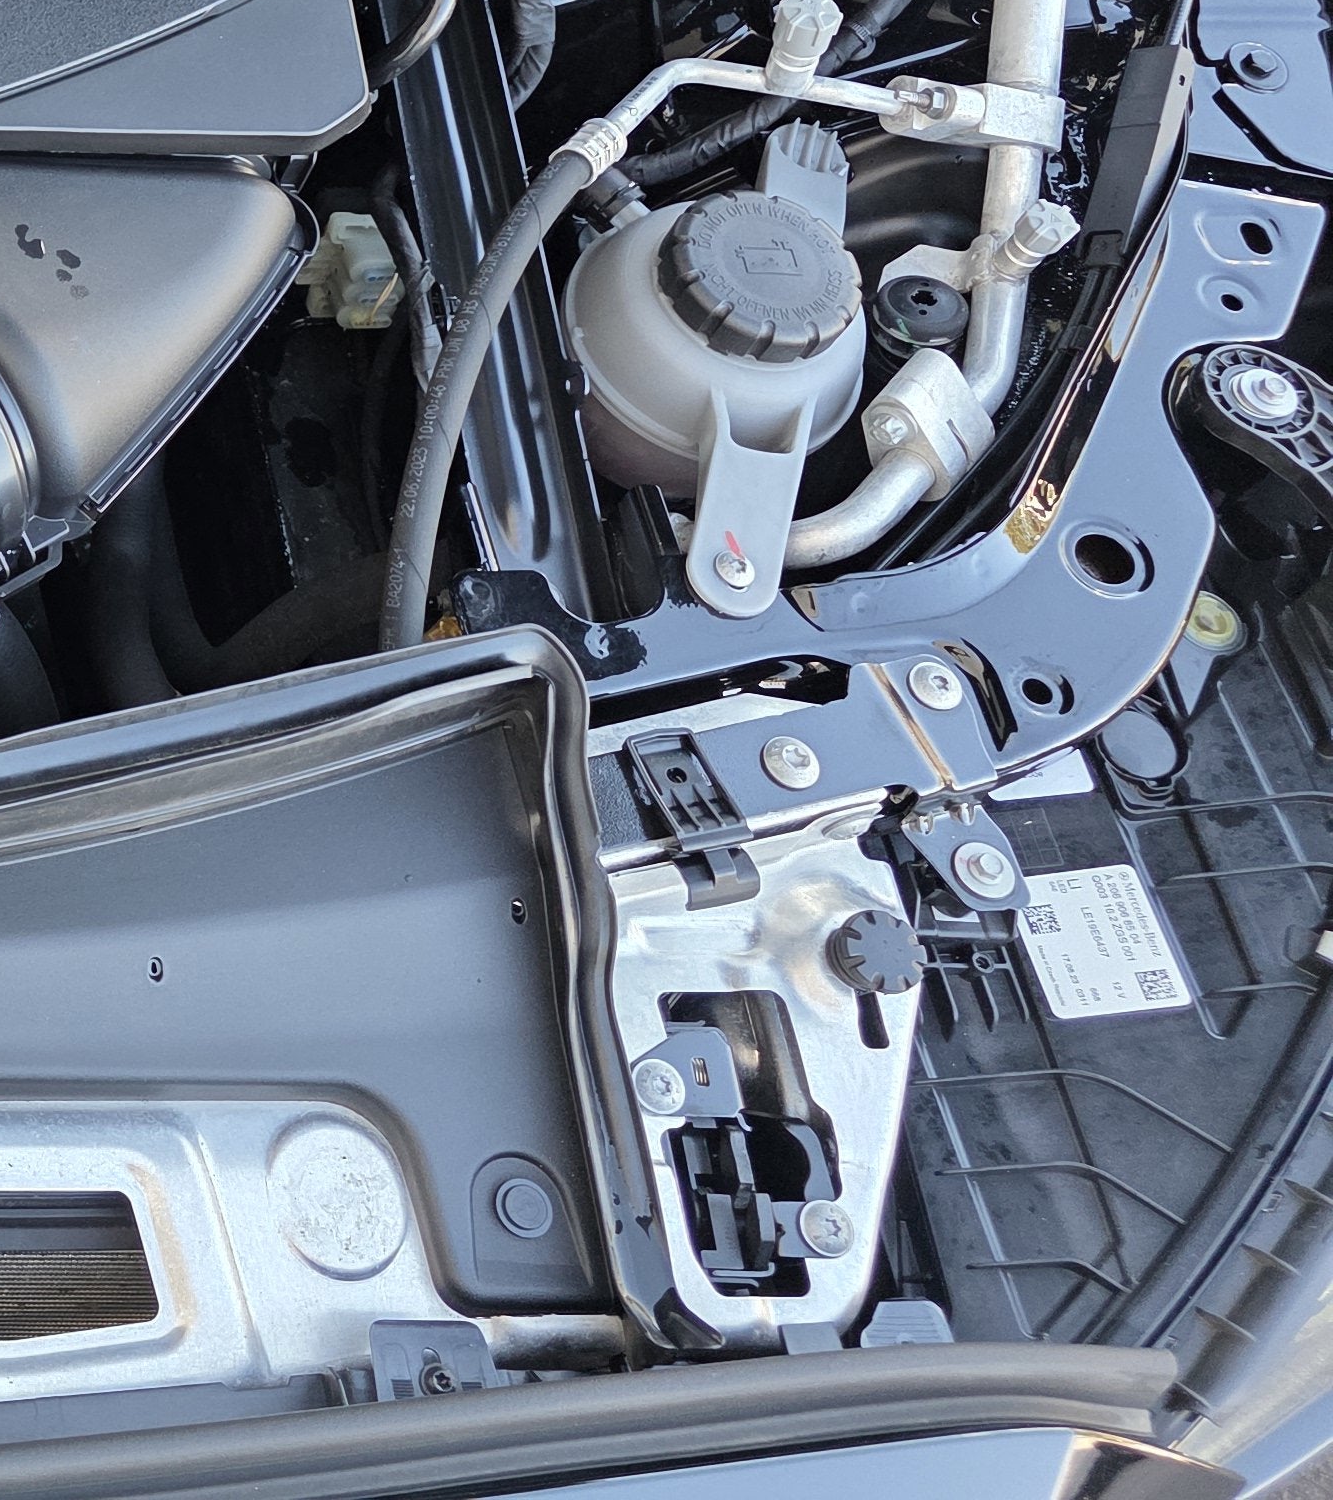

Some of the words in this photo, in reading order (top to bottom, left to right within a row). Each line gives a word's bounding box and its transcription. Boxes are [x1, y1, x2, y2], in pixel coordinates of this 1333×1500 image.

[697, 231, 712, 249] DO
[709, 212, 727, 233] NOT
[727, 202, 763, 216] OPEN
[768, 205, 810, 232] WHEN
[386, 547, 405, 608] BA2074-1
[400, 446, 428, 518] 22.06.2023
[418, 384, 447, 445] 10:00:46
[445, 337, 464, 353] DN
[463, 300, 478, 315] H3
[1056, 879, 1068, 894] LED
[1067, 878, 1082, 890] LI
[1080, 906, 1110, 958] LE19E6437
[1091, 875, 1108, 899] Q003
[1112, 924, 1128, 947] ZGS
[1122, 949, 1137, 961] 001
[1106, 882, 1121, 900] 206
[1129, 933, 1142, 945] 04
[1124, 882, 1162, 957] Mercedes-Benz
[1112, 981, 1123, 991] 12
